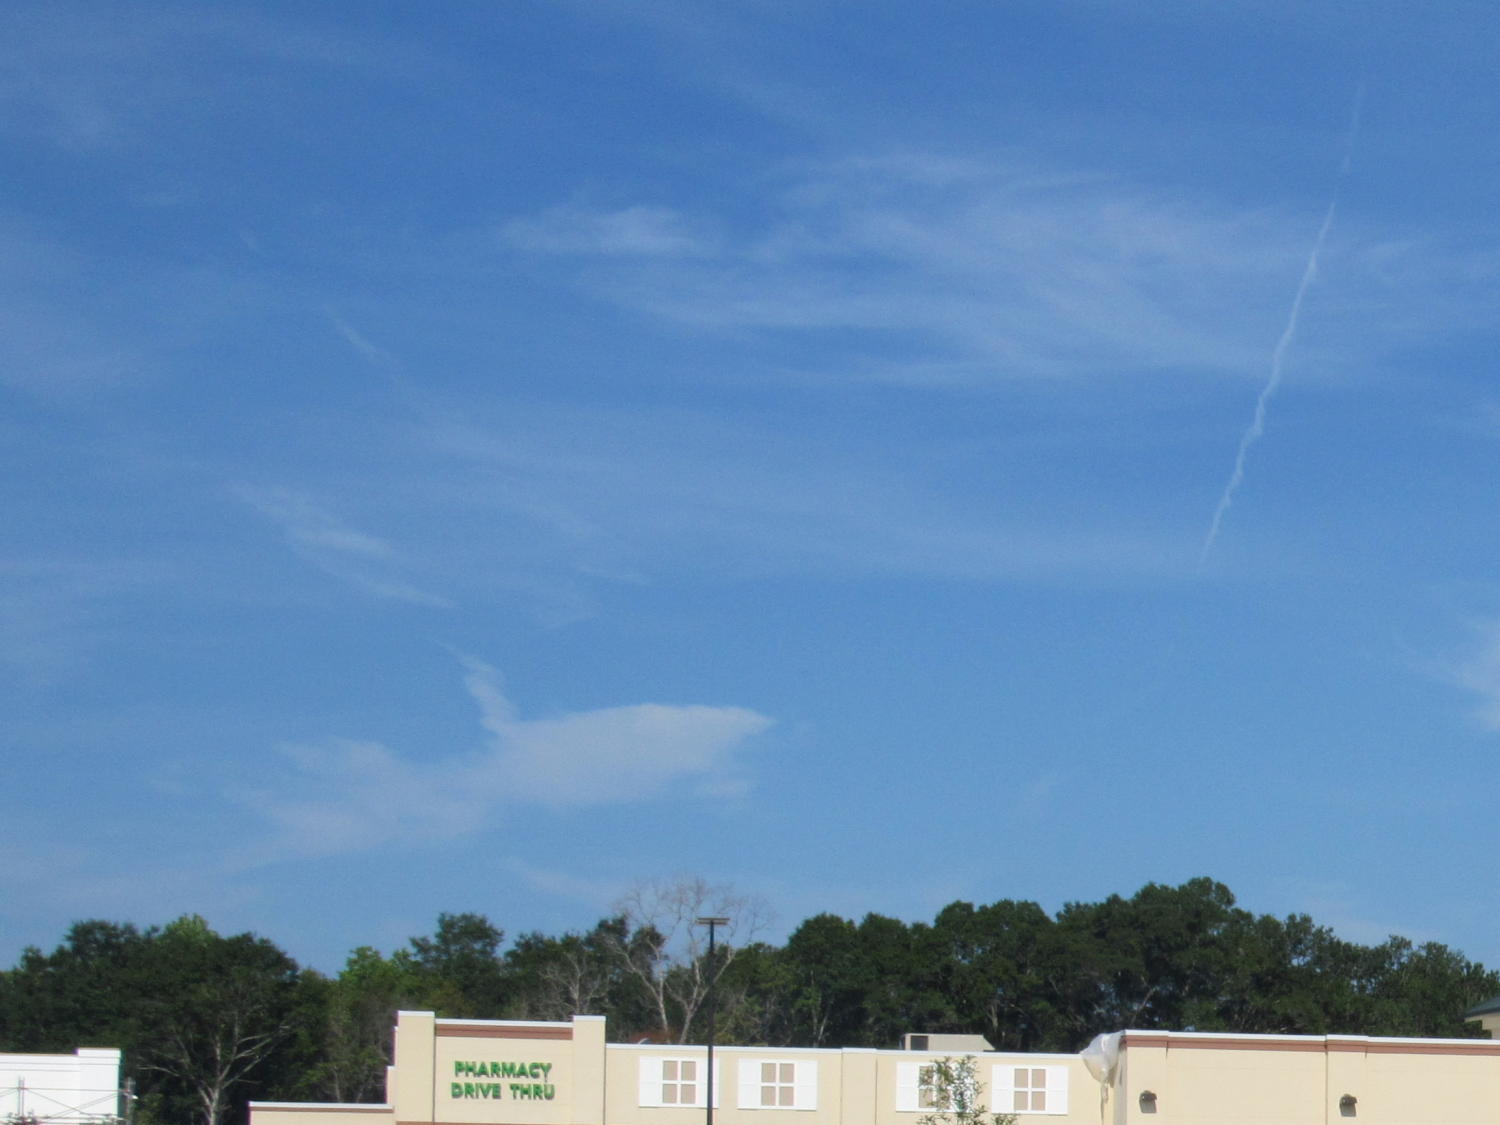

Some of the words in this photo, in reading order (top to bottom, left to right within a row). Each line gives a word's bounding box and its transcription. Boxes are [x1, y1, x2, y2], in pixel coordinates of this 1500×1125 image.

[454, 1061, 552, 1082] PHARMACY
[451, 1082, 501, 1099] DRIVE
[510, 1084, 555, 1100] THRU
